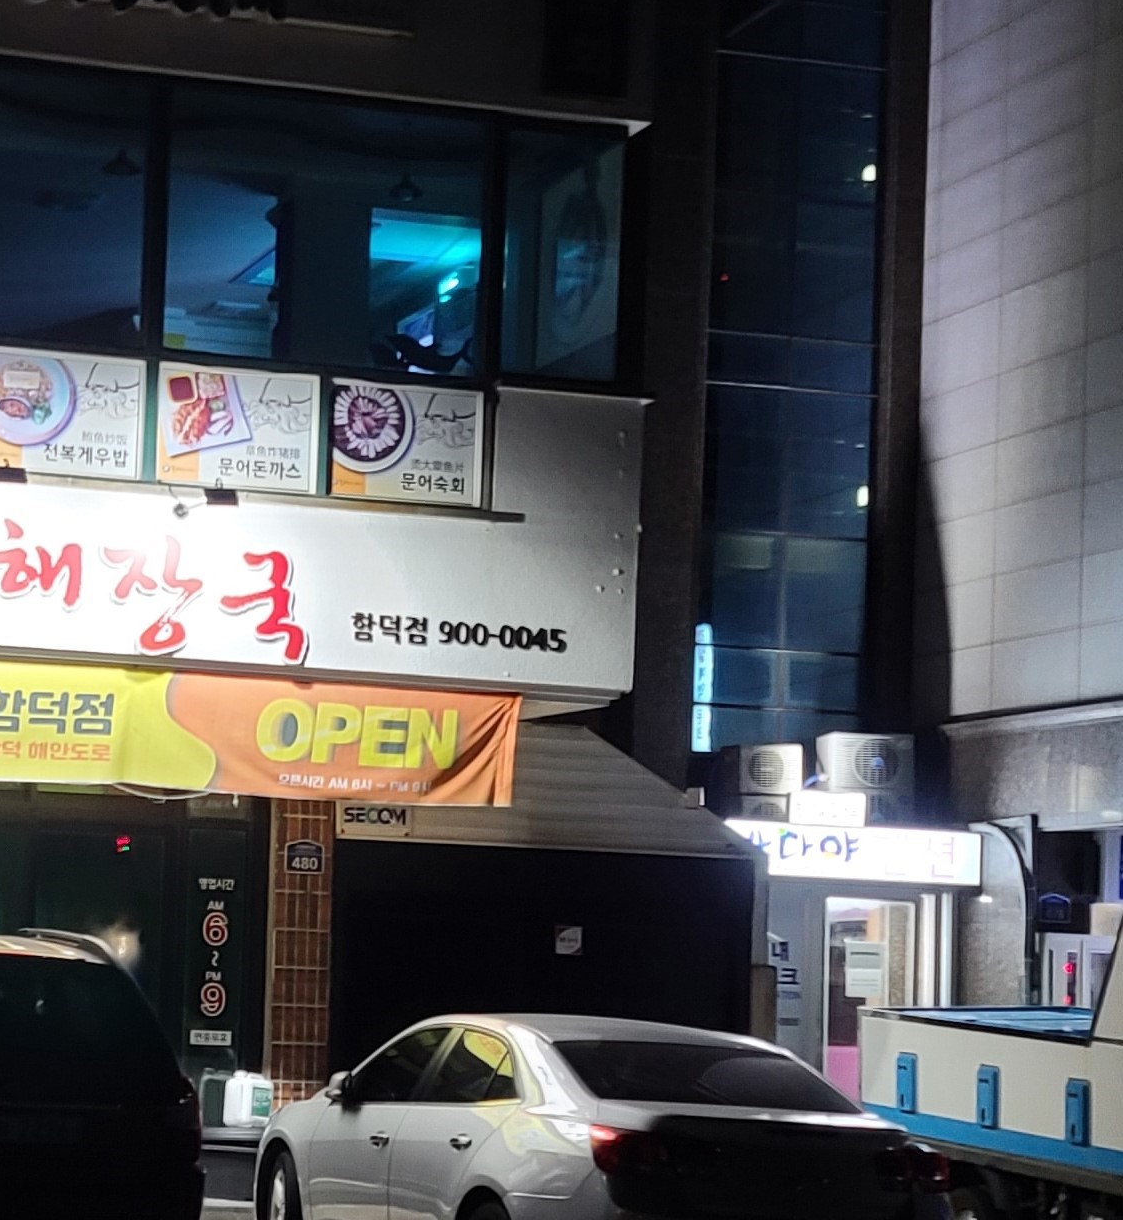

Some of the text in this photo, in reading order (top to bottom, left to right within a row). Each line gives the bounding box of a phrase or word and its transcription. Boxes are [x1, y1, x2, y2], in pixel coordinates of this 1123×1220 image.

[43, 443, 129, 468] 전복게우밥
[218, 458, 302, 480] 문어돈까스
[400, 472, 465, 496] 문어숙회
[351, 611, 568, 654] 함덕점 900-0045
[255, 697, 460, 771] OPEN
[28, 741, 111, 761] 해안도로
[327, 776, 348, 790] AM
[343, 806, 406, 826] SECOM
[290, 856, 319, 870] 480
[206, 900, 225, 911] AM
[202, 911, 229, 947] 6
[205, 970, 222, 981] PM
[199, 982, 226, 1017] 9
